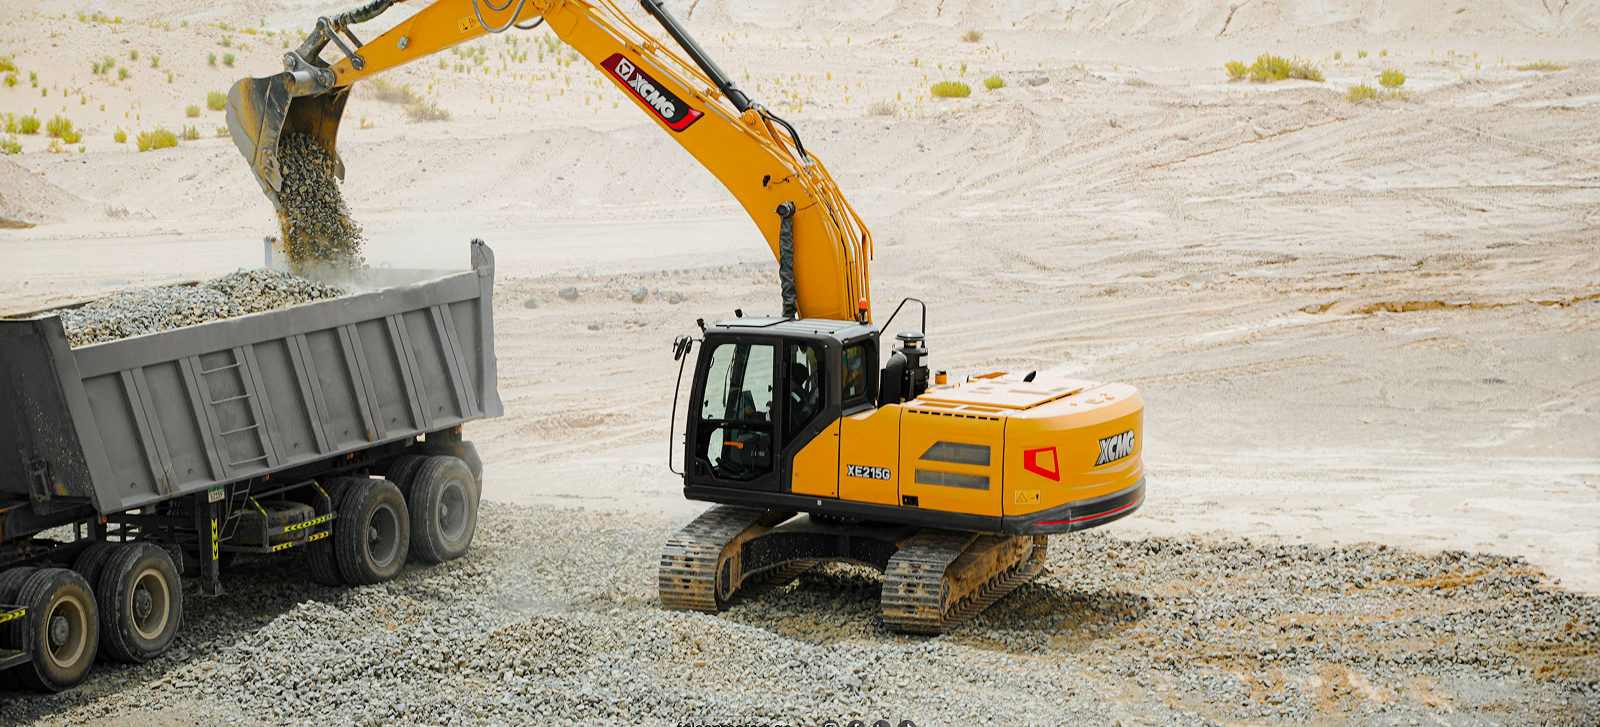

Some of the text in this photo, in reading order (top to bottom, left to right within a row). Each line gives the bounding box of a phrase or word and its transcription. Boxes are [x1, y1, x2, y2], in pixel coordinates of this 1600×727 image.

[627, 72, 676, 119] XCMG
[1095, 429, 1135, 466] XCMG
[847, 464, 891, 480] XE215G
